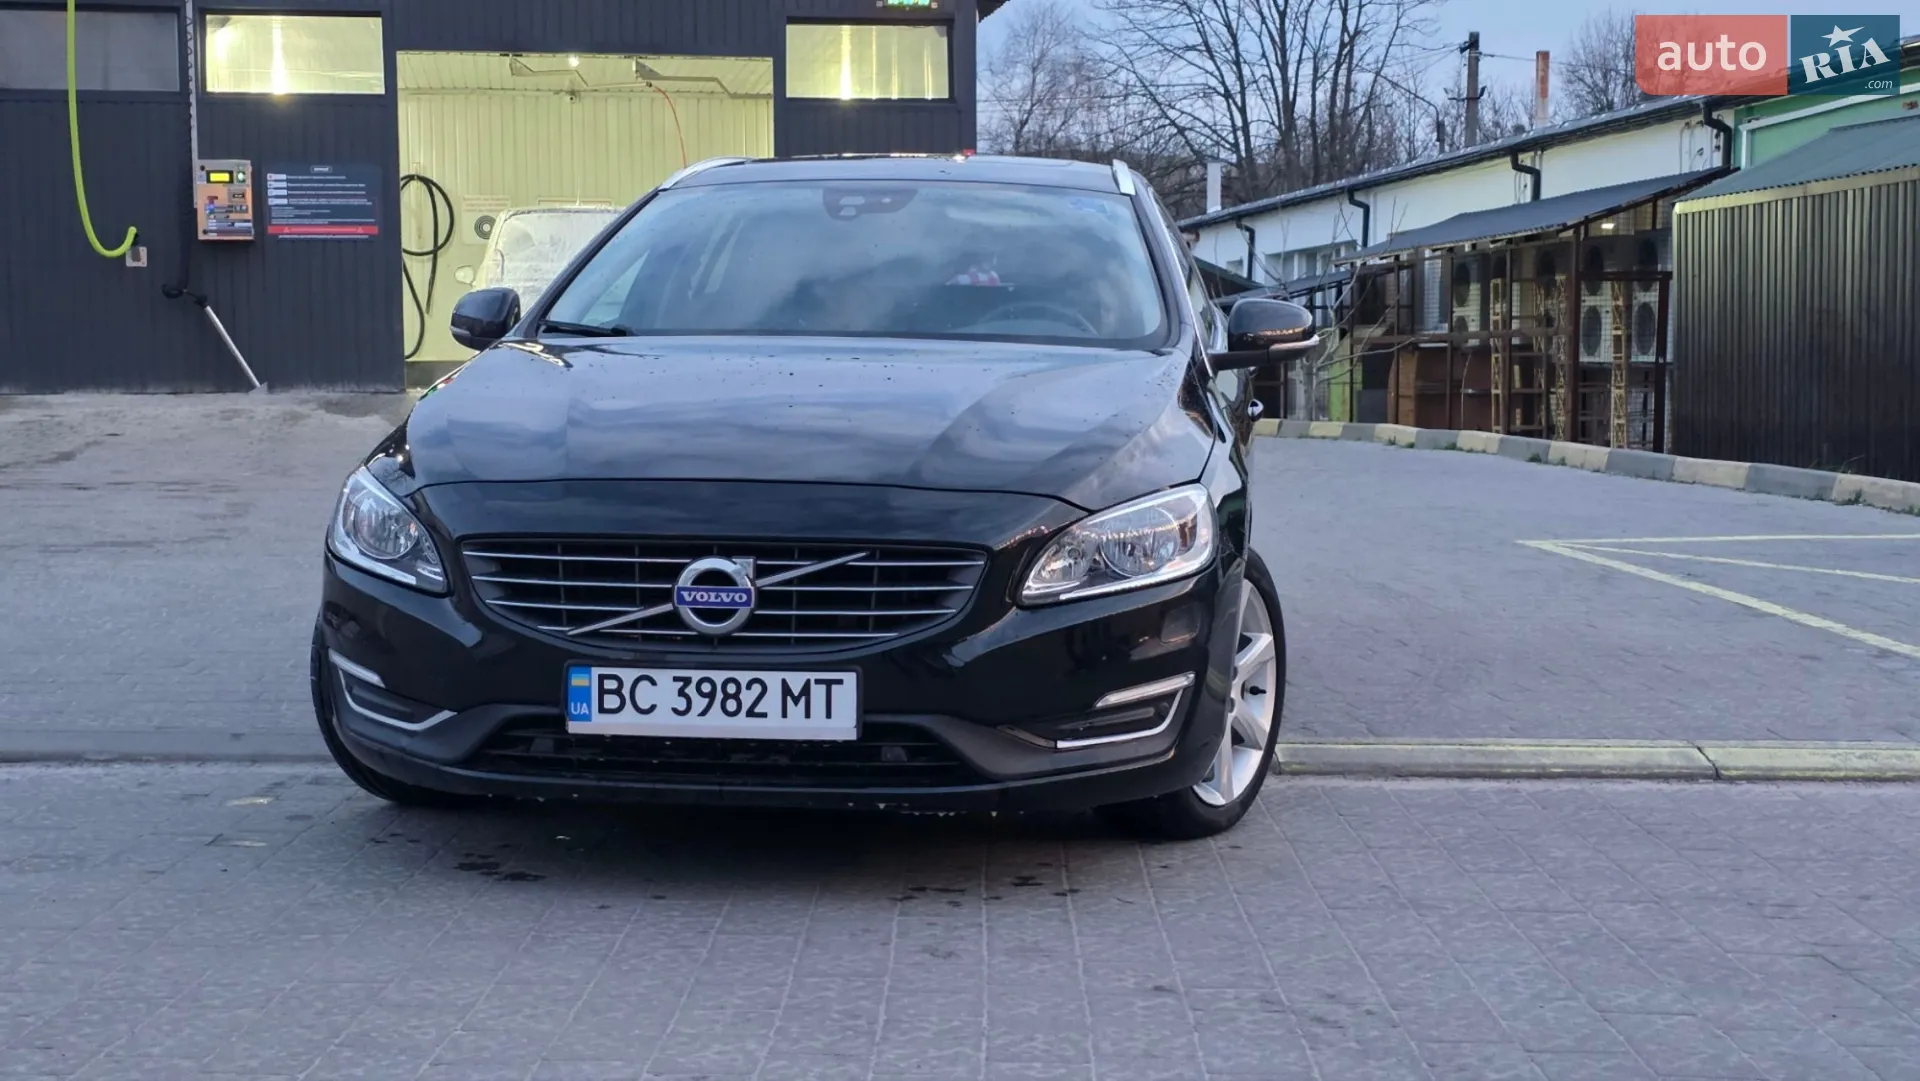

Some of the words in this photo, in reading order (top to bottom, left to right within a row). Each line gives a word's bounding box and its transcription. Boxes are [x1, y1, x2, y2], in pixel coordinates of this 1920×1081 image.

[680, 591, 748, 603] VOLVO
[597, 673, 658, 715] BC
[670, 675, 768, 718] 3982
[781, 677, 844, 719] MT
[571, 702, 589, 715] UA
